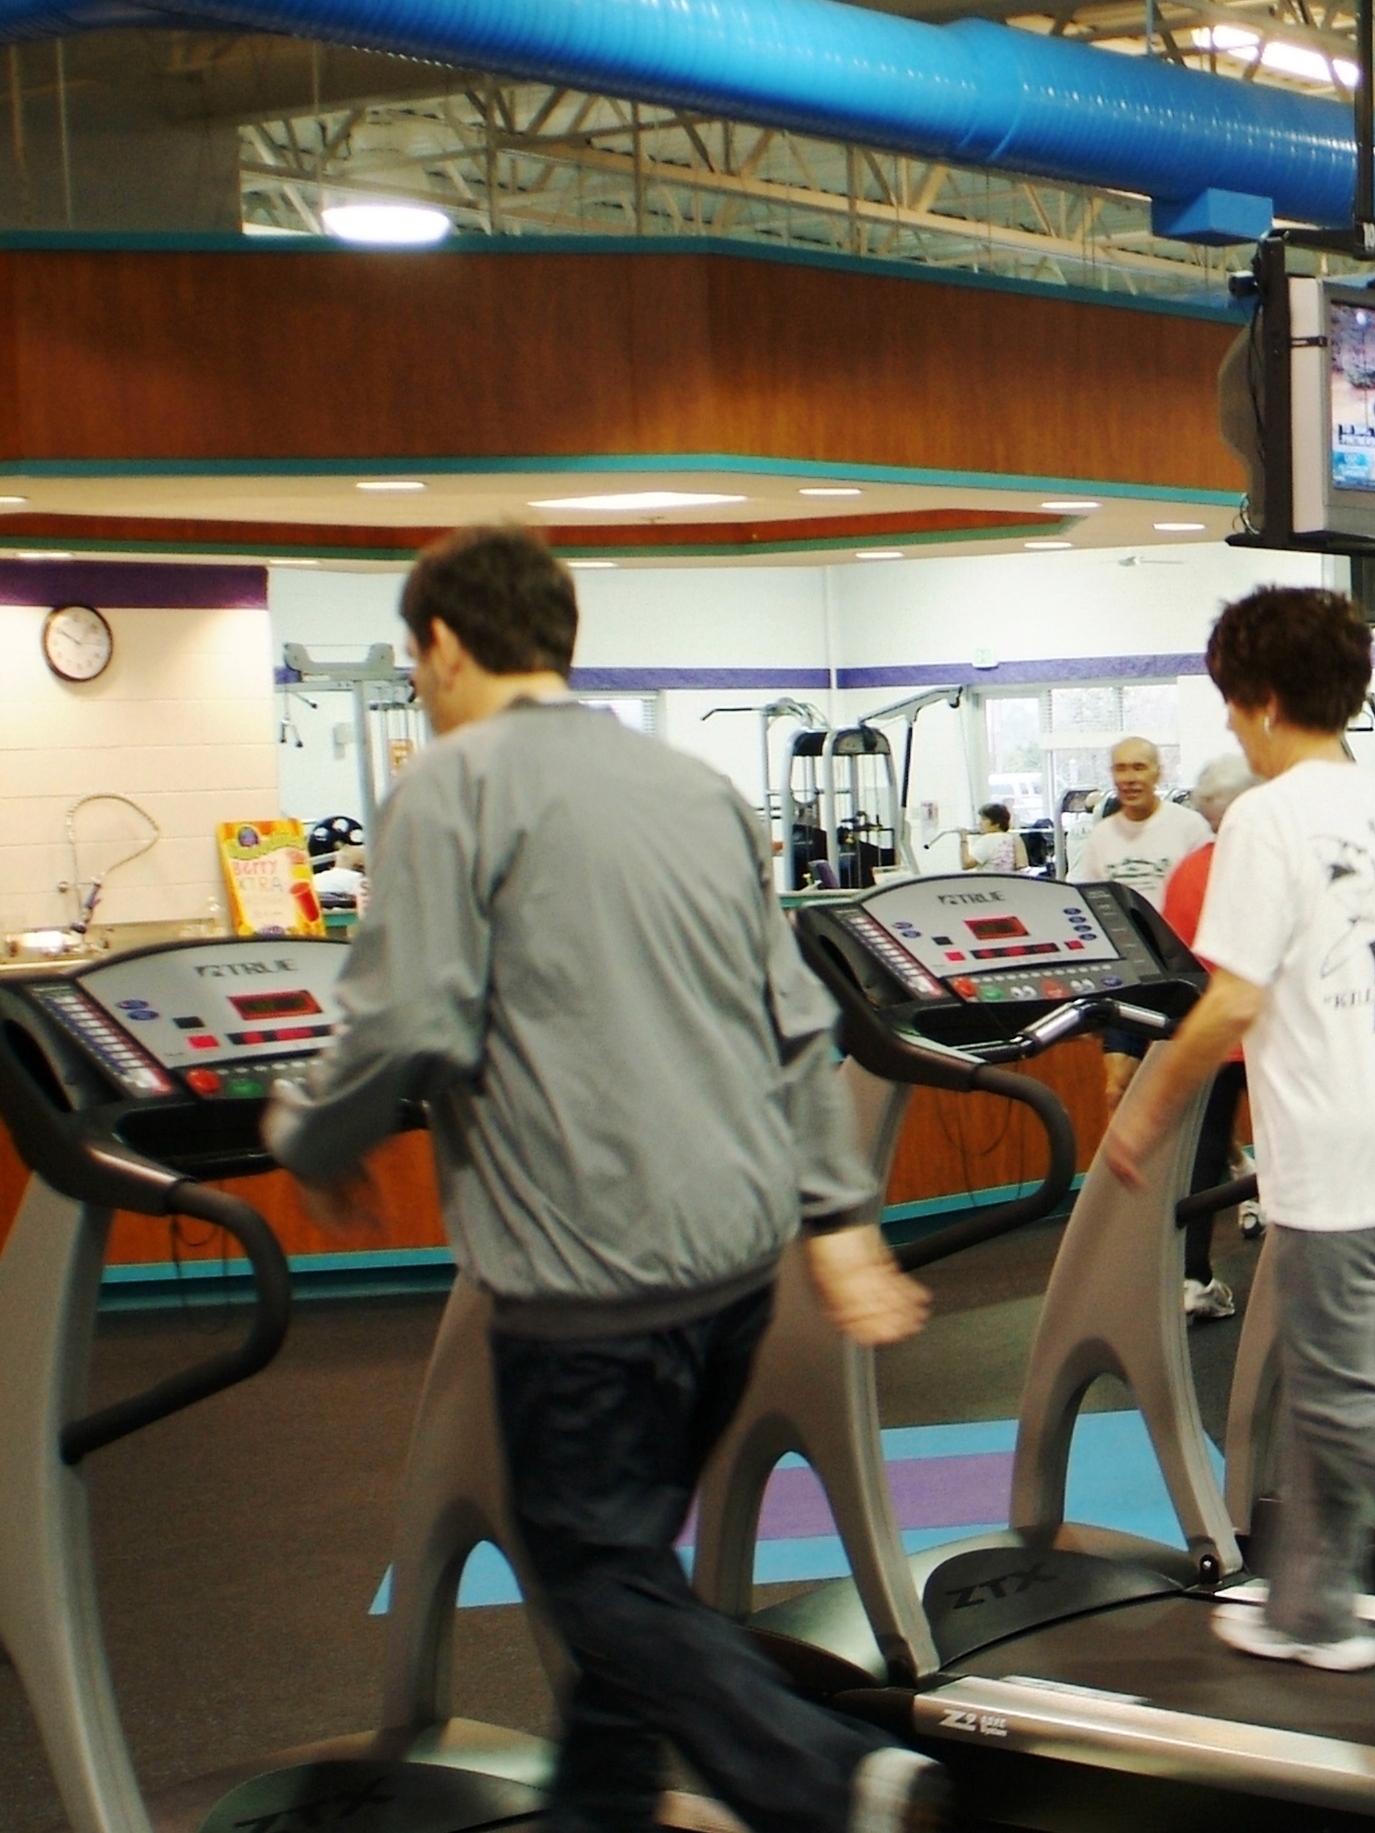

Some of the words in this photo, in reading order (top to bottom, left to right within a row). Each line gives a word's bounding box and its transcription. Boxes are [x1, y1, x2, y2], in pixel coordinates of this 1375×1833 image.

[956, 890, 1005, 905] TRUE
[222, 958, 299, 975] TRUE
[945, 1562, 1060, 1610] ZTX
